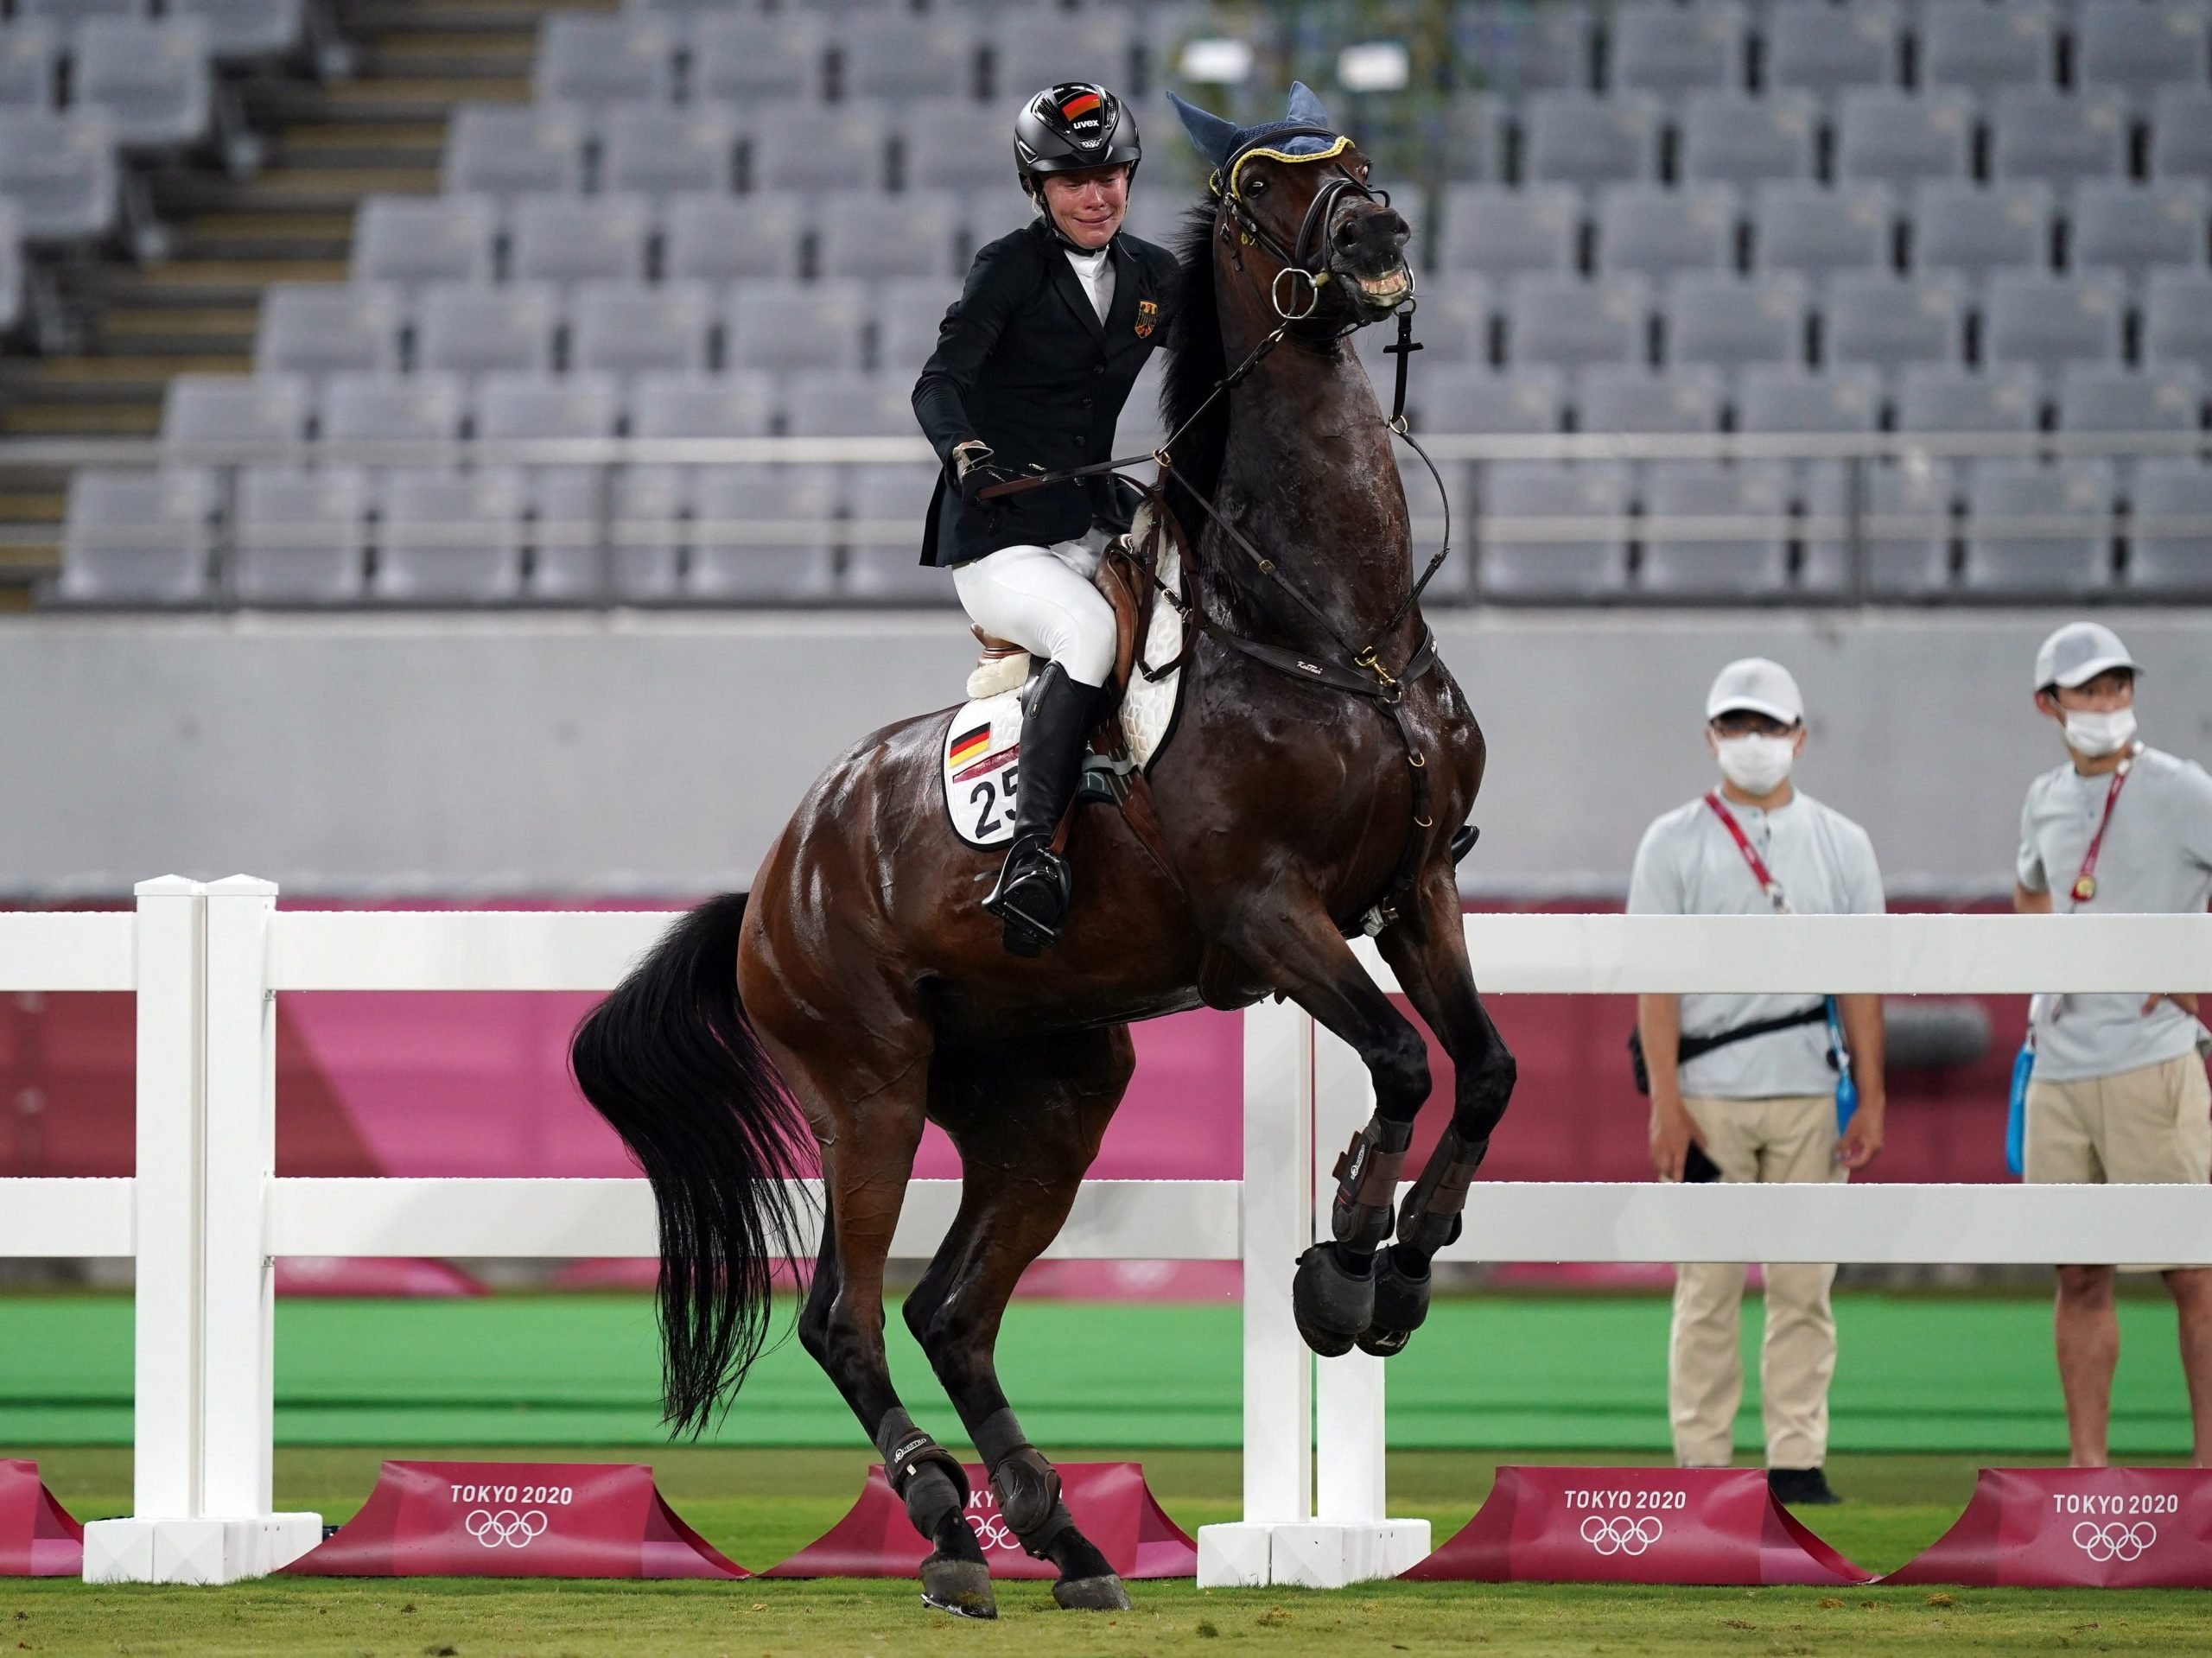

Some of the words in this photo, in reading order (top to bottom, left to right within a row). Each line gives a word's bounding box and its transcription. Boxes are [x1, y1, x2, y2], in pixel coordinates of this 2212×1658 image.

[1073, 119, 1100, 130] uvex
[969, 765, 1019, 840] 25
[450, 1484, 518, 1503] TOKYO
[521, 1486, 573, 1505] 2020
[1564, 1490, 1631, 1509] TOKYO
[1636, 1490, 1687, 1509] 2020
[2053, 1494, 2124, 1515] TOKYO
[2128, 1494, 2178, 1515] 2020
